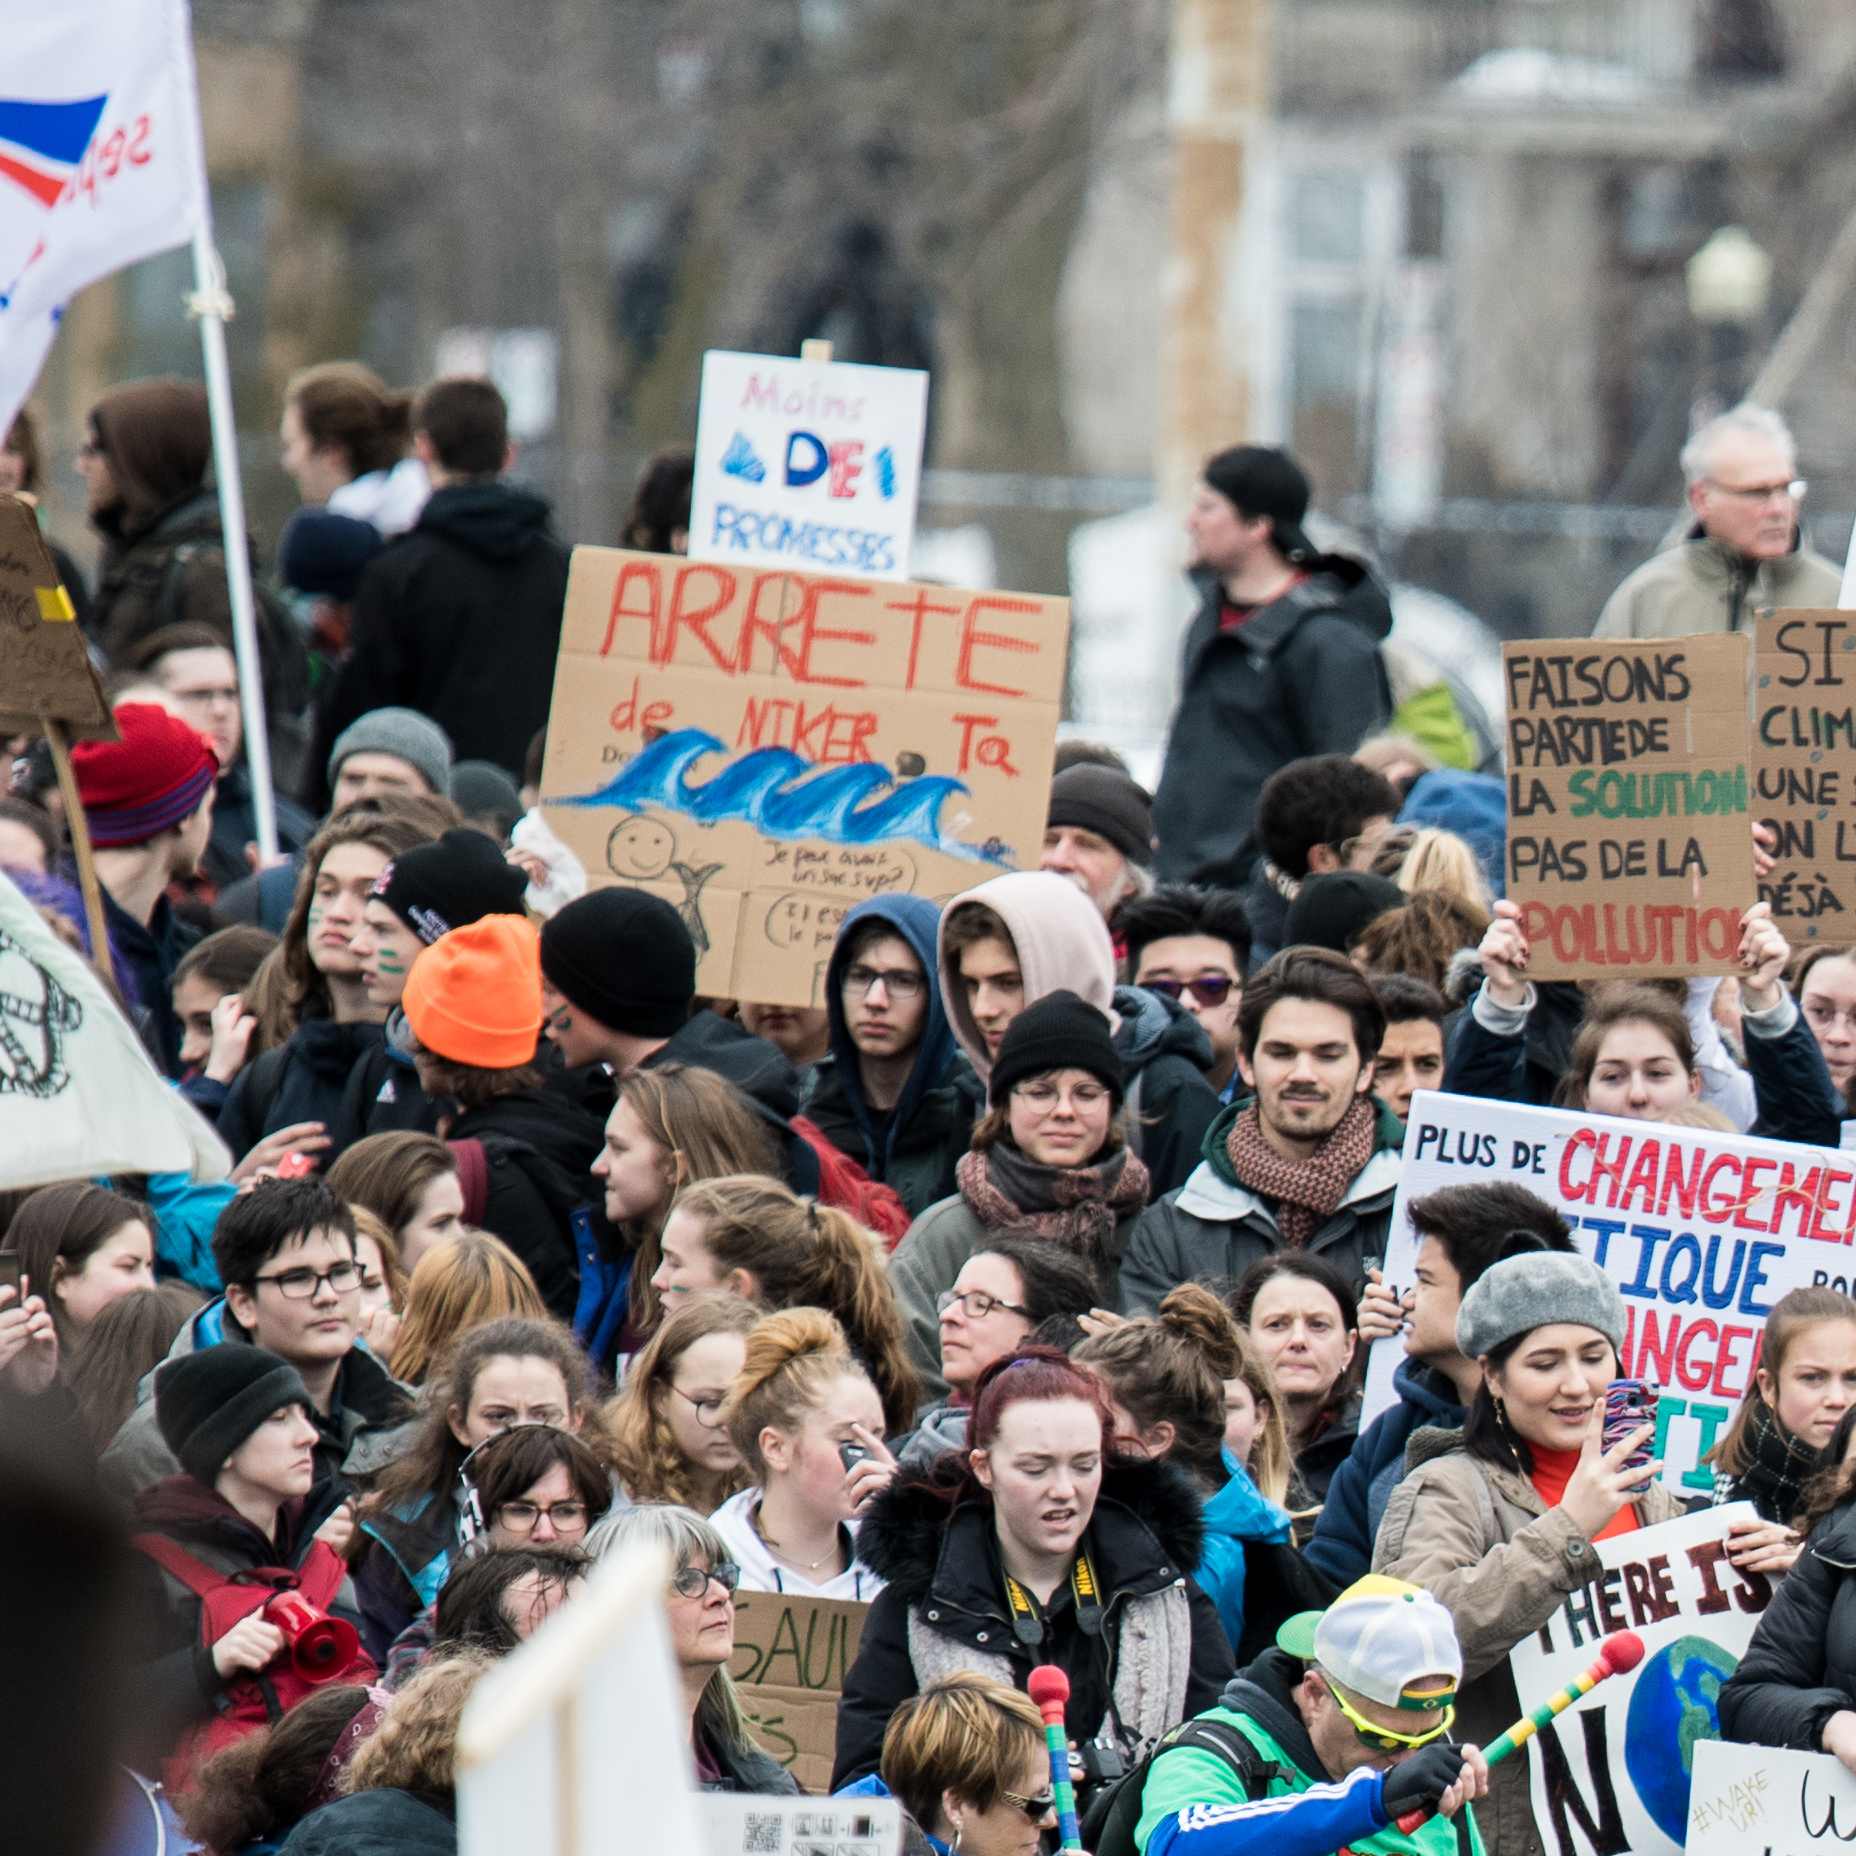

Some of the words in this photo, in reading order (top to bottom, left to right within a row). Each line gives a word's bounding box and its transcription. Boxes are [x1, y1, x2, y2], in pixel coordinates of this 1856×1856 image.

[711, 502, 895, 571] PROMESSES
[601, 562, 1043, 698] ARRETE
[1776, 621, 1848, 688] SI
[609, 676, 675, 735] de
[1506, 653, 1691, 710] FAISONS
[1511, 773, 1556, 817] LA
[1567, 764, 1748, 819] SOLUTION
[1756, 767, 1840, 807] UNE
[1510, 837, 1588, 883] PAS
[1601, 839, 1648, 880] DE
[1657, 837, 1708, 883] LA
[1765, 818, 1814, 859] ON
[1757, 871, 1844, 919] DÉJÀ
[1416, 1122, 1496, 1168] PLUS
[1511, 1138, 1547, 1175] DE
